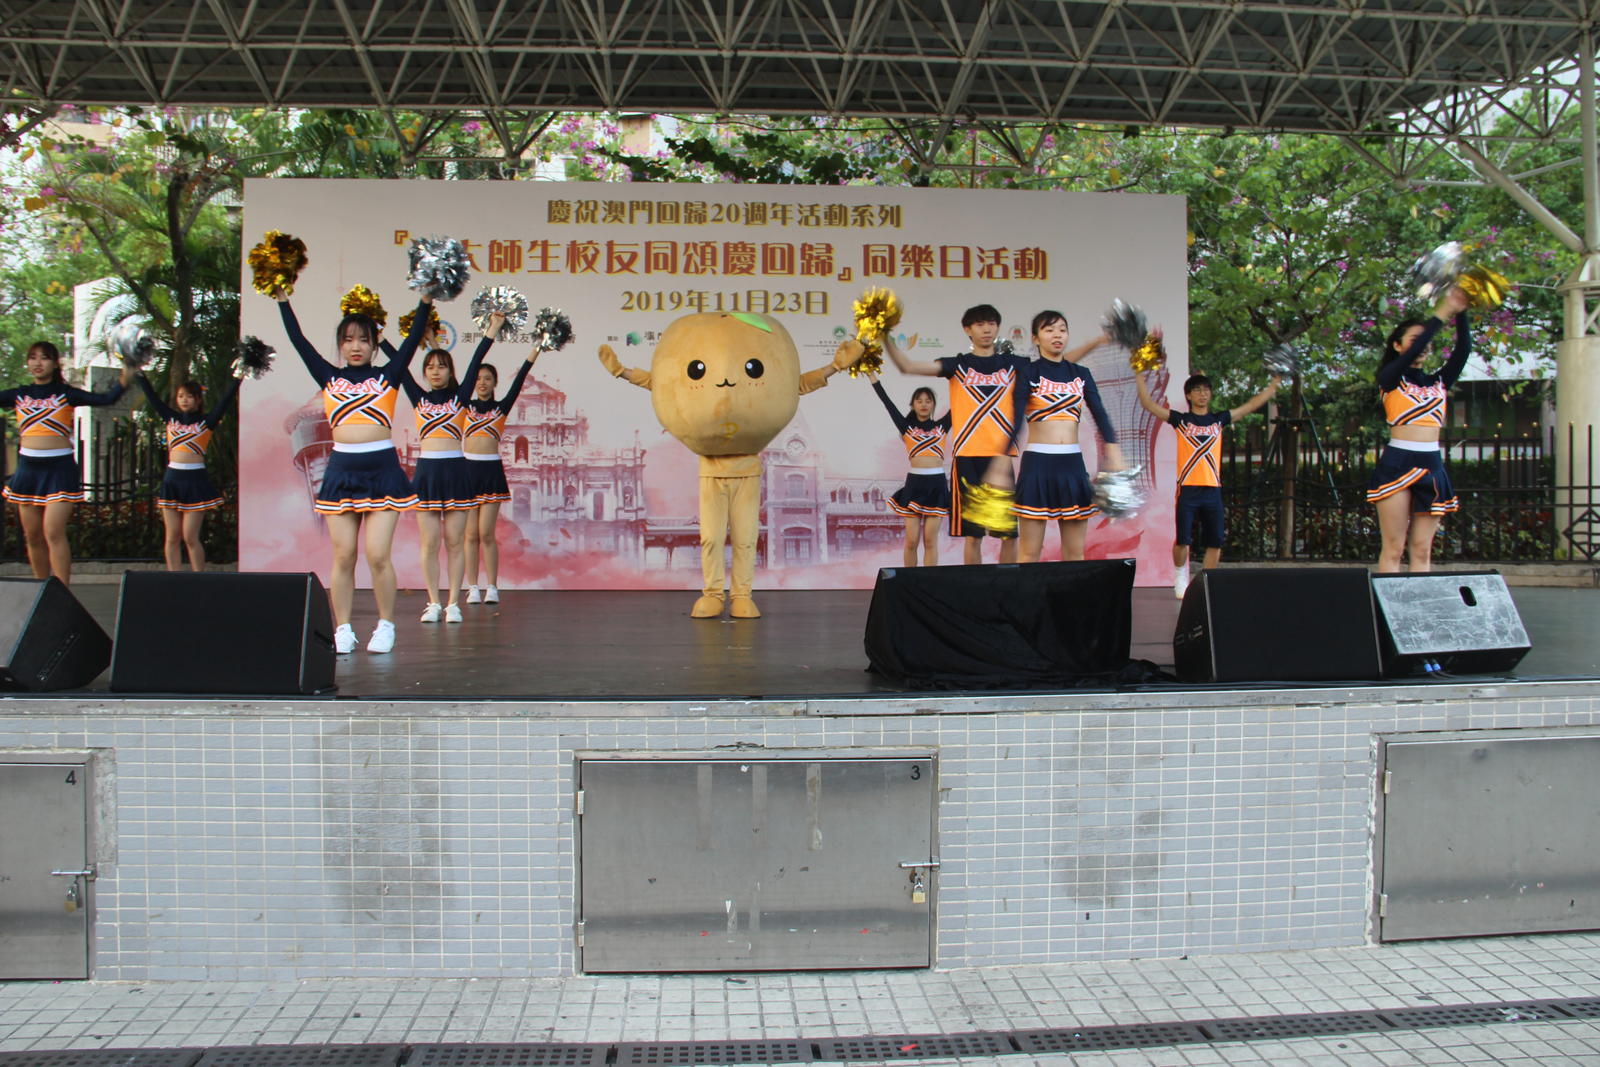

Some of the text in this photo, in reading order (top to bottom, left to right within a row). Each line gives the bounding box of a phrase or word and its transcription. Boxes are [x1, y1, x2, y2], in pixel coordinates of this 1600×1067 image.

[547, 199, 903, 228] 慶祝澳門回歸20週年活動系列
[620, 289, 830, 315] 2019年11月23日
[65, 770, 76, 786] 4
[911, 765, 921, 780] 3
